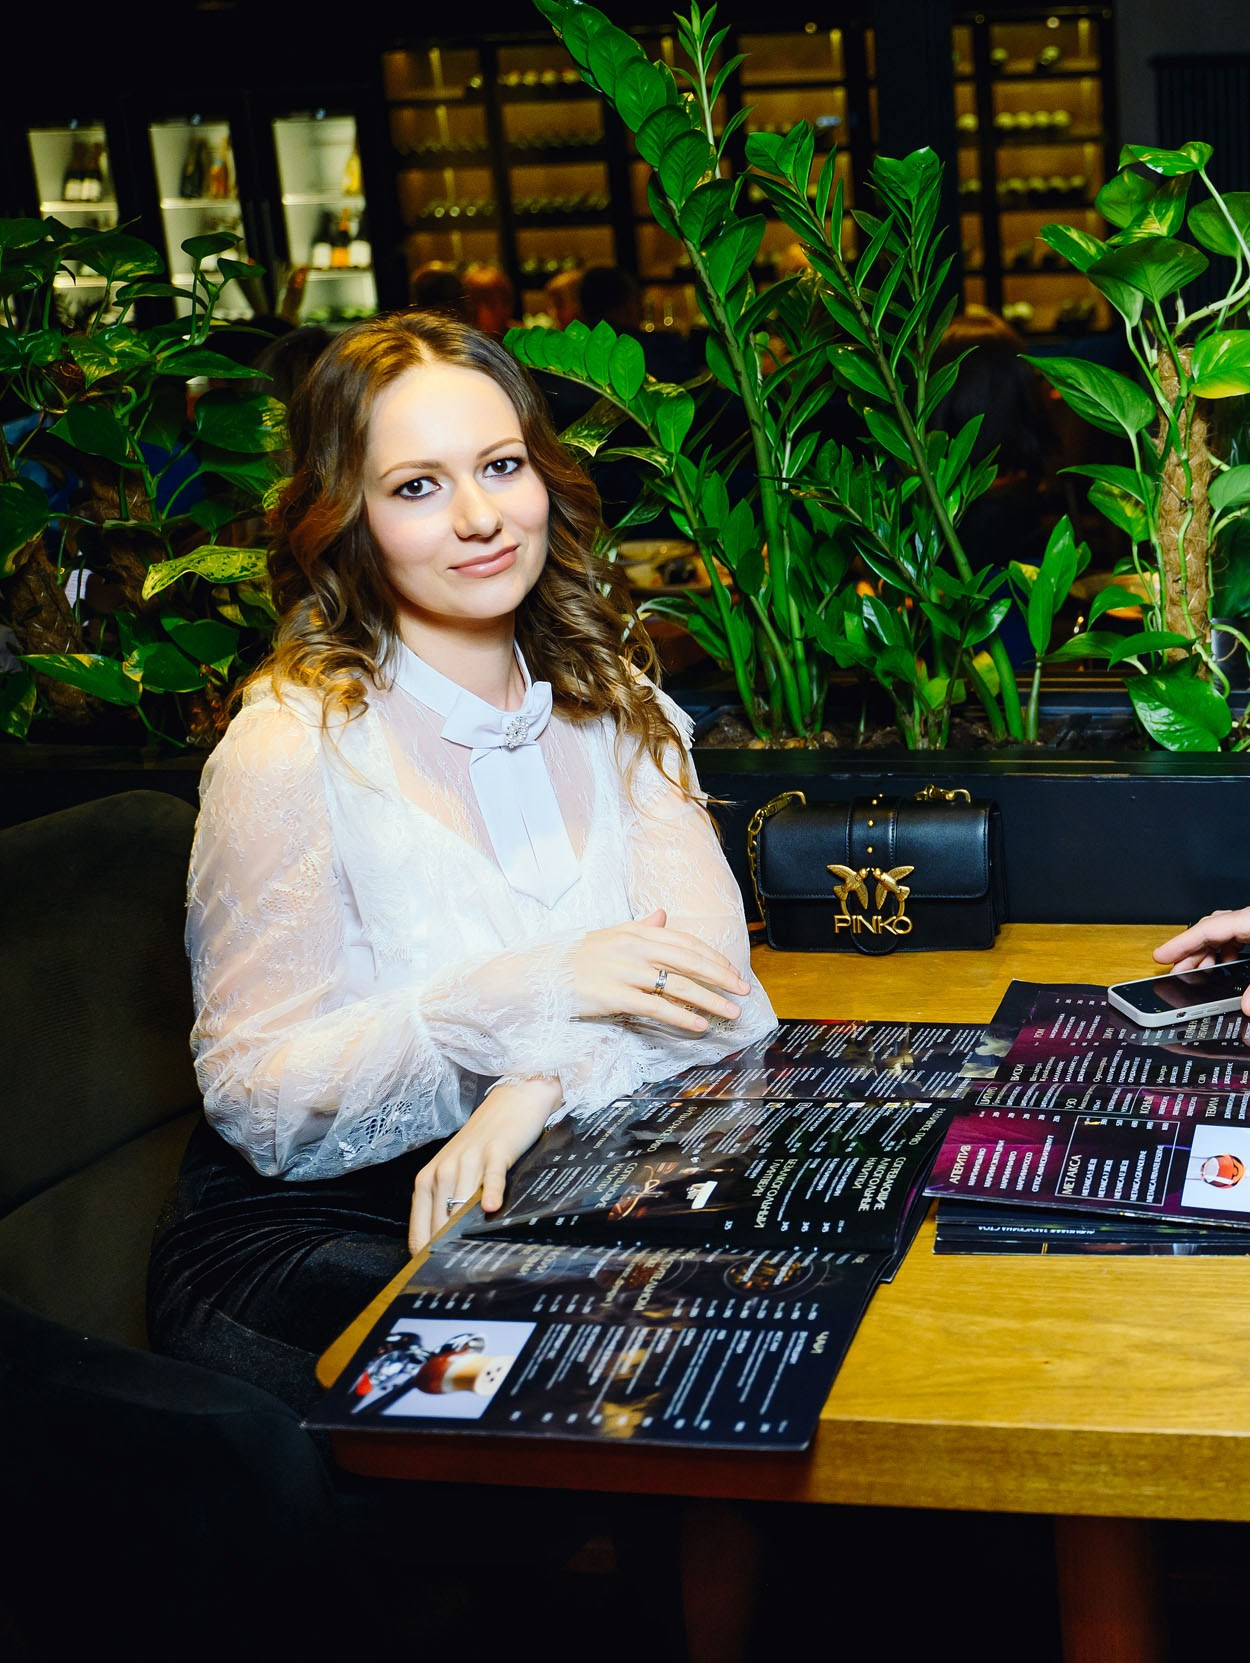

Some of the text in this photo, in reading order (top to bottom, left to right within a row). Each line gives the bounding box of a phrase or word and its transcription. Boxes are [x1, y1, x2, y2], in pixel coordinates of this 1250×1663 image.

[834, 915, 913, 935] PINKO
[1065, 1098, 1077, 1108] УЗО
[1205, 1097, 1219, 1117] ТЕКИЛА
[908, 1132, 926, 1145] ПИВО
[593, 1163, 625, 1193] НАПИТКИ
[752, 1159, 783, 1197] ГЛИНТВЕЙН
[852, 1157, 877, 1189] НАПИТКИ
[949, 1144, 971, 1184] АПЕРИТИВ
[1062, 1155, 1082, 1195] МЕТАКСА
[595, 1162, 637, 1208] СОГРЕВАЮЩИЕ
[755, 1158, 797, 1228] БЕЗАЛКОГОЛЬНЫЙ
[858, 1158, 890, 1211] АЛКОГОЛЬНЫЕ
[873, 1157, 906, 1210] СОГРЕВАЮЩИЕ
[808, 1330, 831, 1354] ЧАЙ
